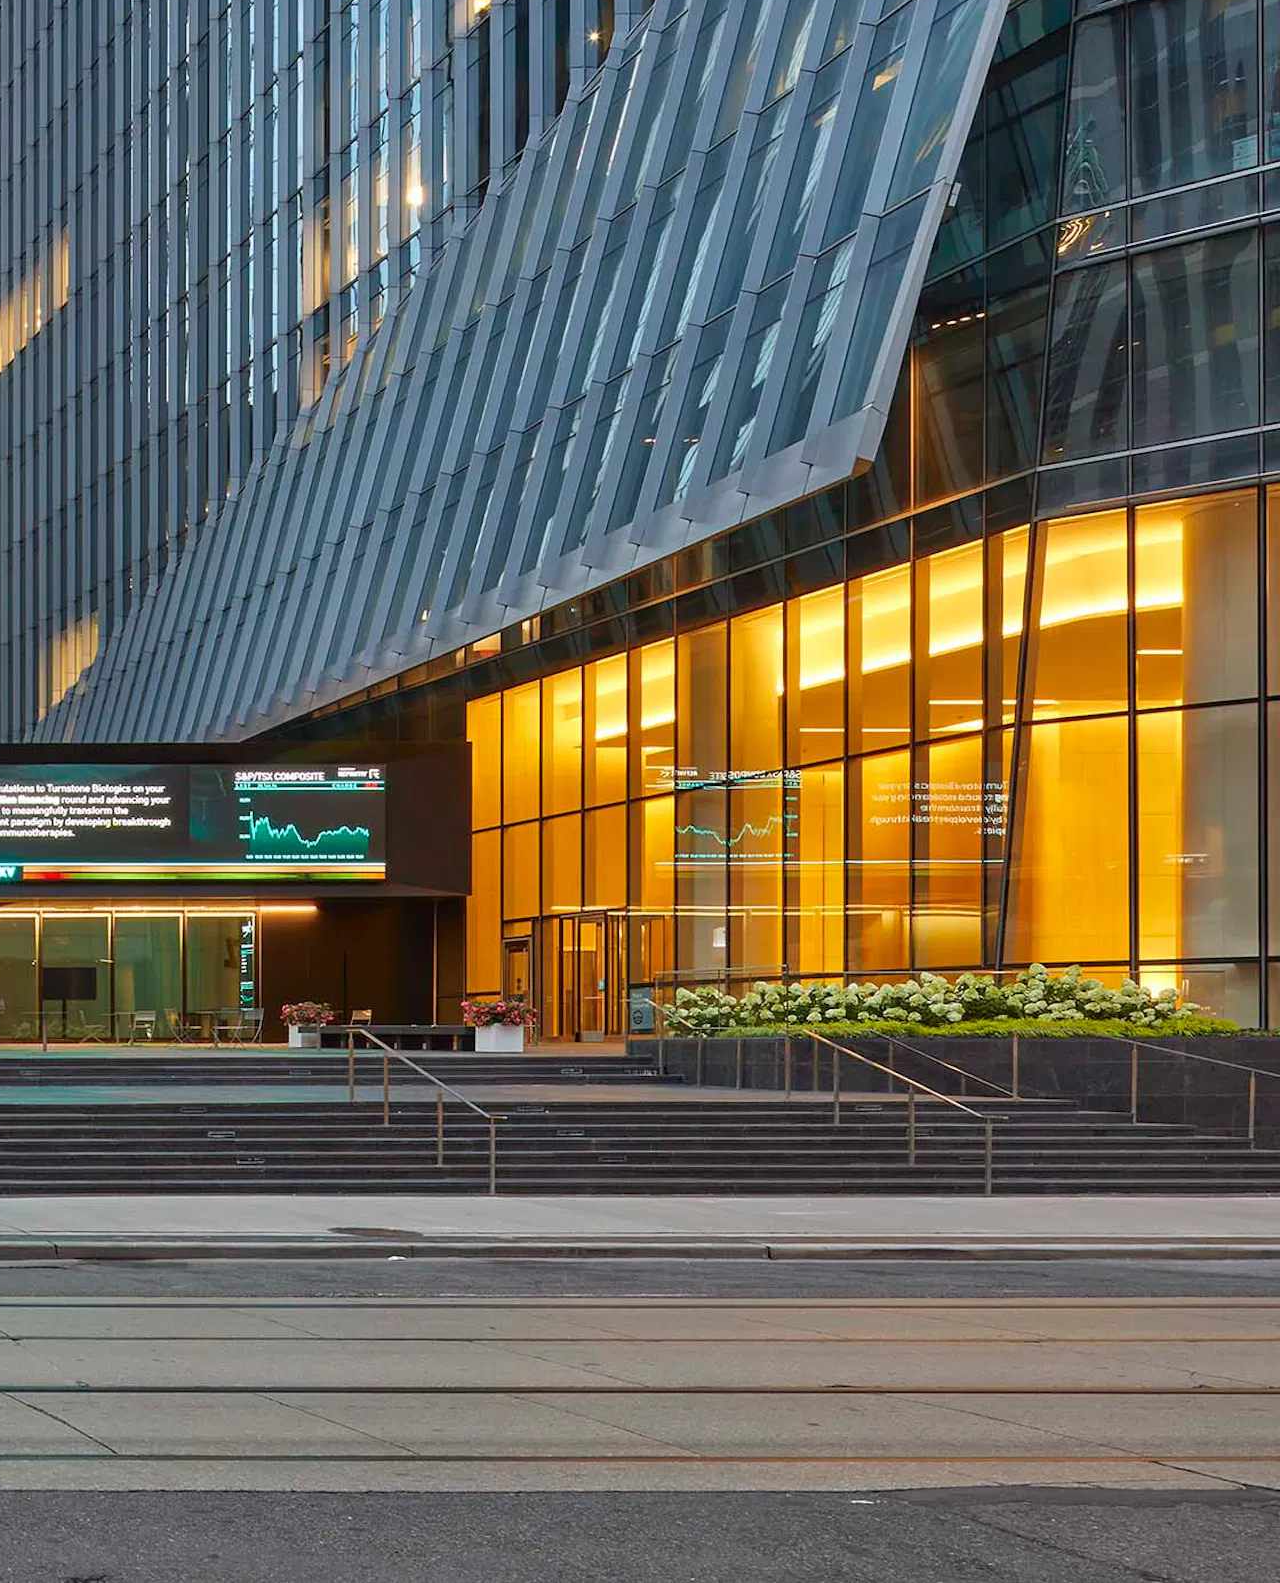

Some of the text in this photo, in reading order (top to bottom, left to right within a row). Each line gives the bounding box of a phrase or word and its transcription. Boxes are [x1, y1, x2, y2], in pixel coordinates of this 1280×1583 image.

[235, 772, 325, 781] S&P/TSX COMPOSITE
[35, 784, 45, 793] to
[47, 784, 90, 793] Turnstone
[92, 784, 131, 795] Biologics
[145, 786, 165, 795] your
[61, 795, 86, 804] round
[88, 795, 105, 804] and
[106, 795, 149, 805] advancing
[151, 797, 171, 805] your
[2, 806, 11, 815] to
[12, 806, 68, 816] meaningfully
[70, 806, 113, 815] transform
[114, 806, 129, 815] the
[11, 817, 52, 828] paradigm
[53, 817, 64, 828] by
[65, 817, 111, 828] developing
[112, 817, 171, 828] breakthrough
